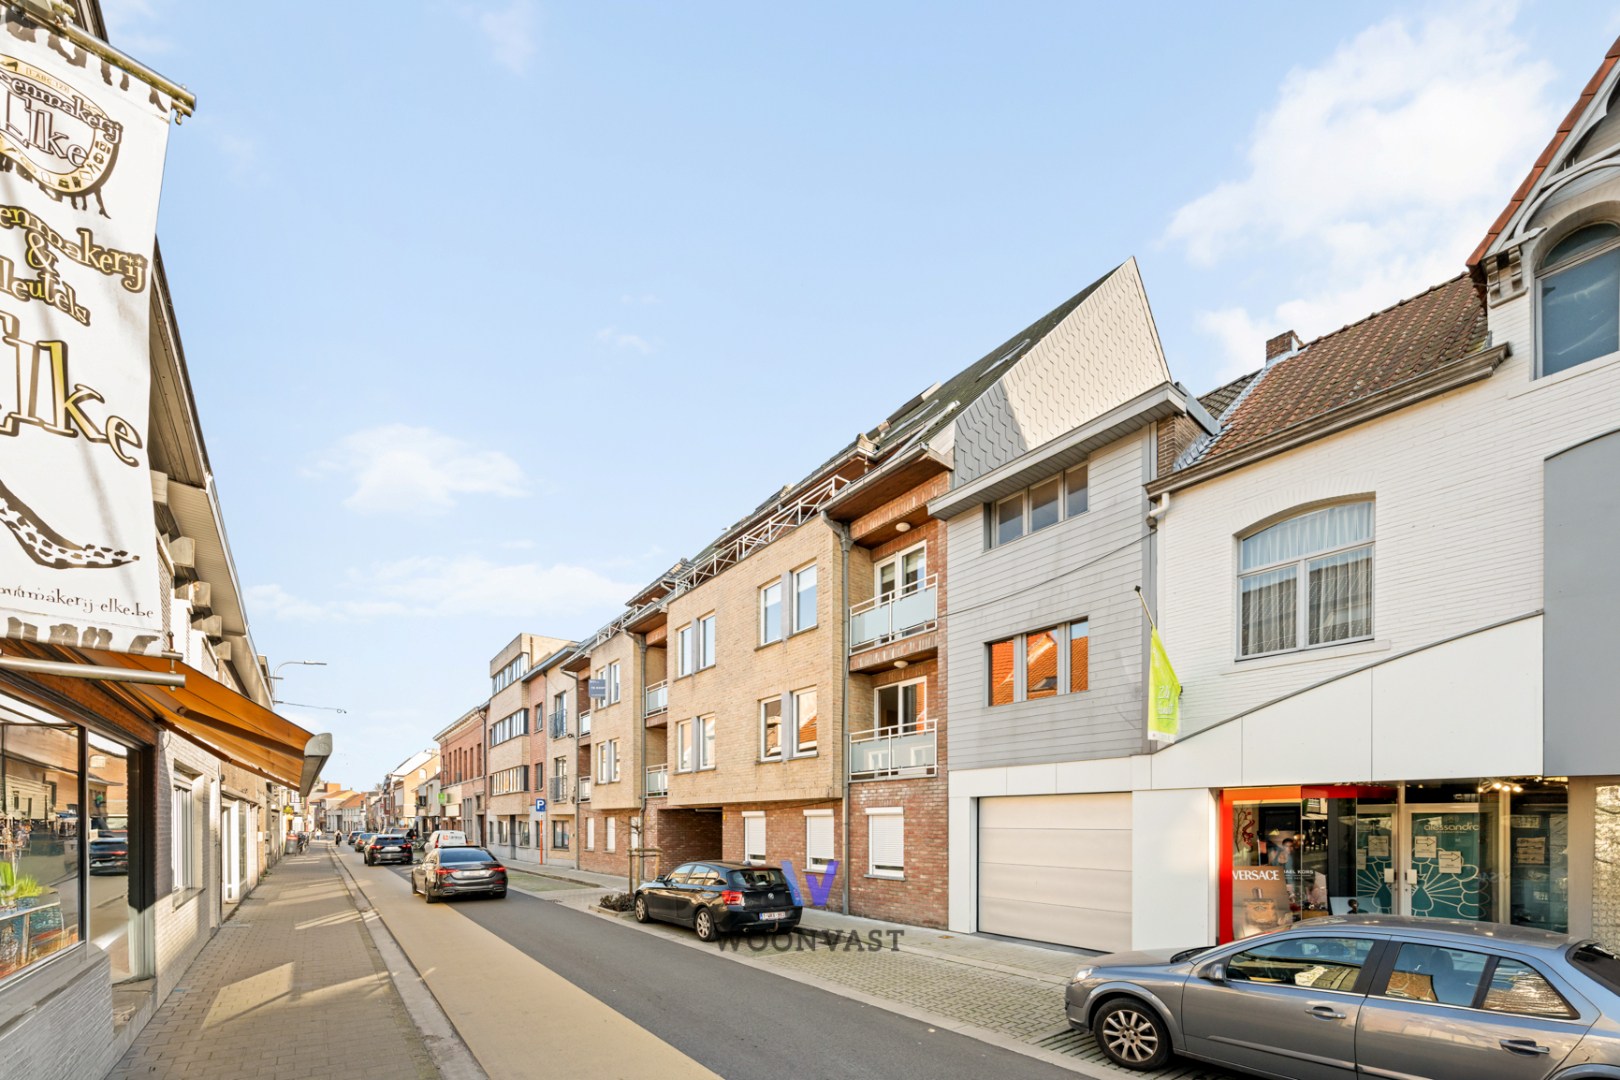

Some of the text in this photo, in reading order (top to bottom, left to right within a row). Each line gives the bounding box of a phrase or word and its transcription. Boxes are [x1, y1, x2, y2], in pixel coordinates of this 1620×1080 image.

[26, 230, 60, 277] &
[537, 800, 545, 810] P
[1232, 869, 1280, 881] VERSACE
